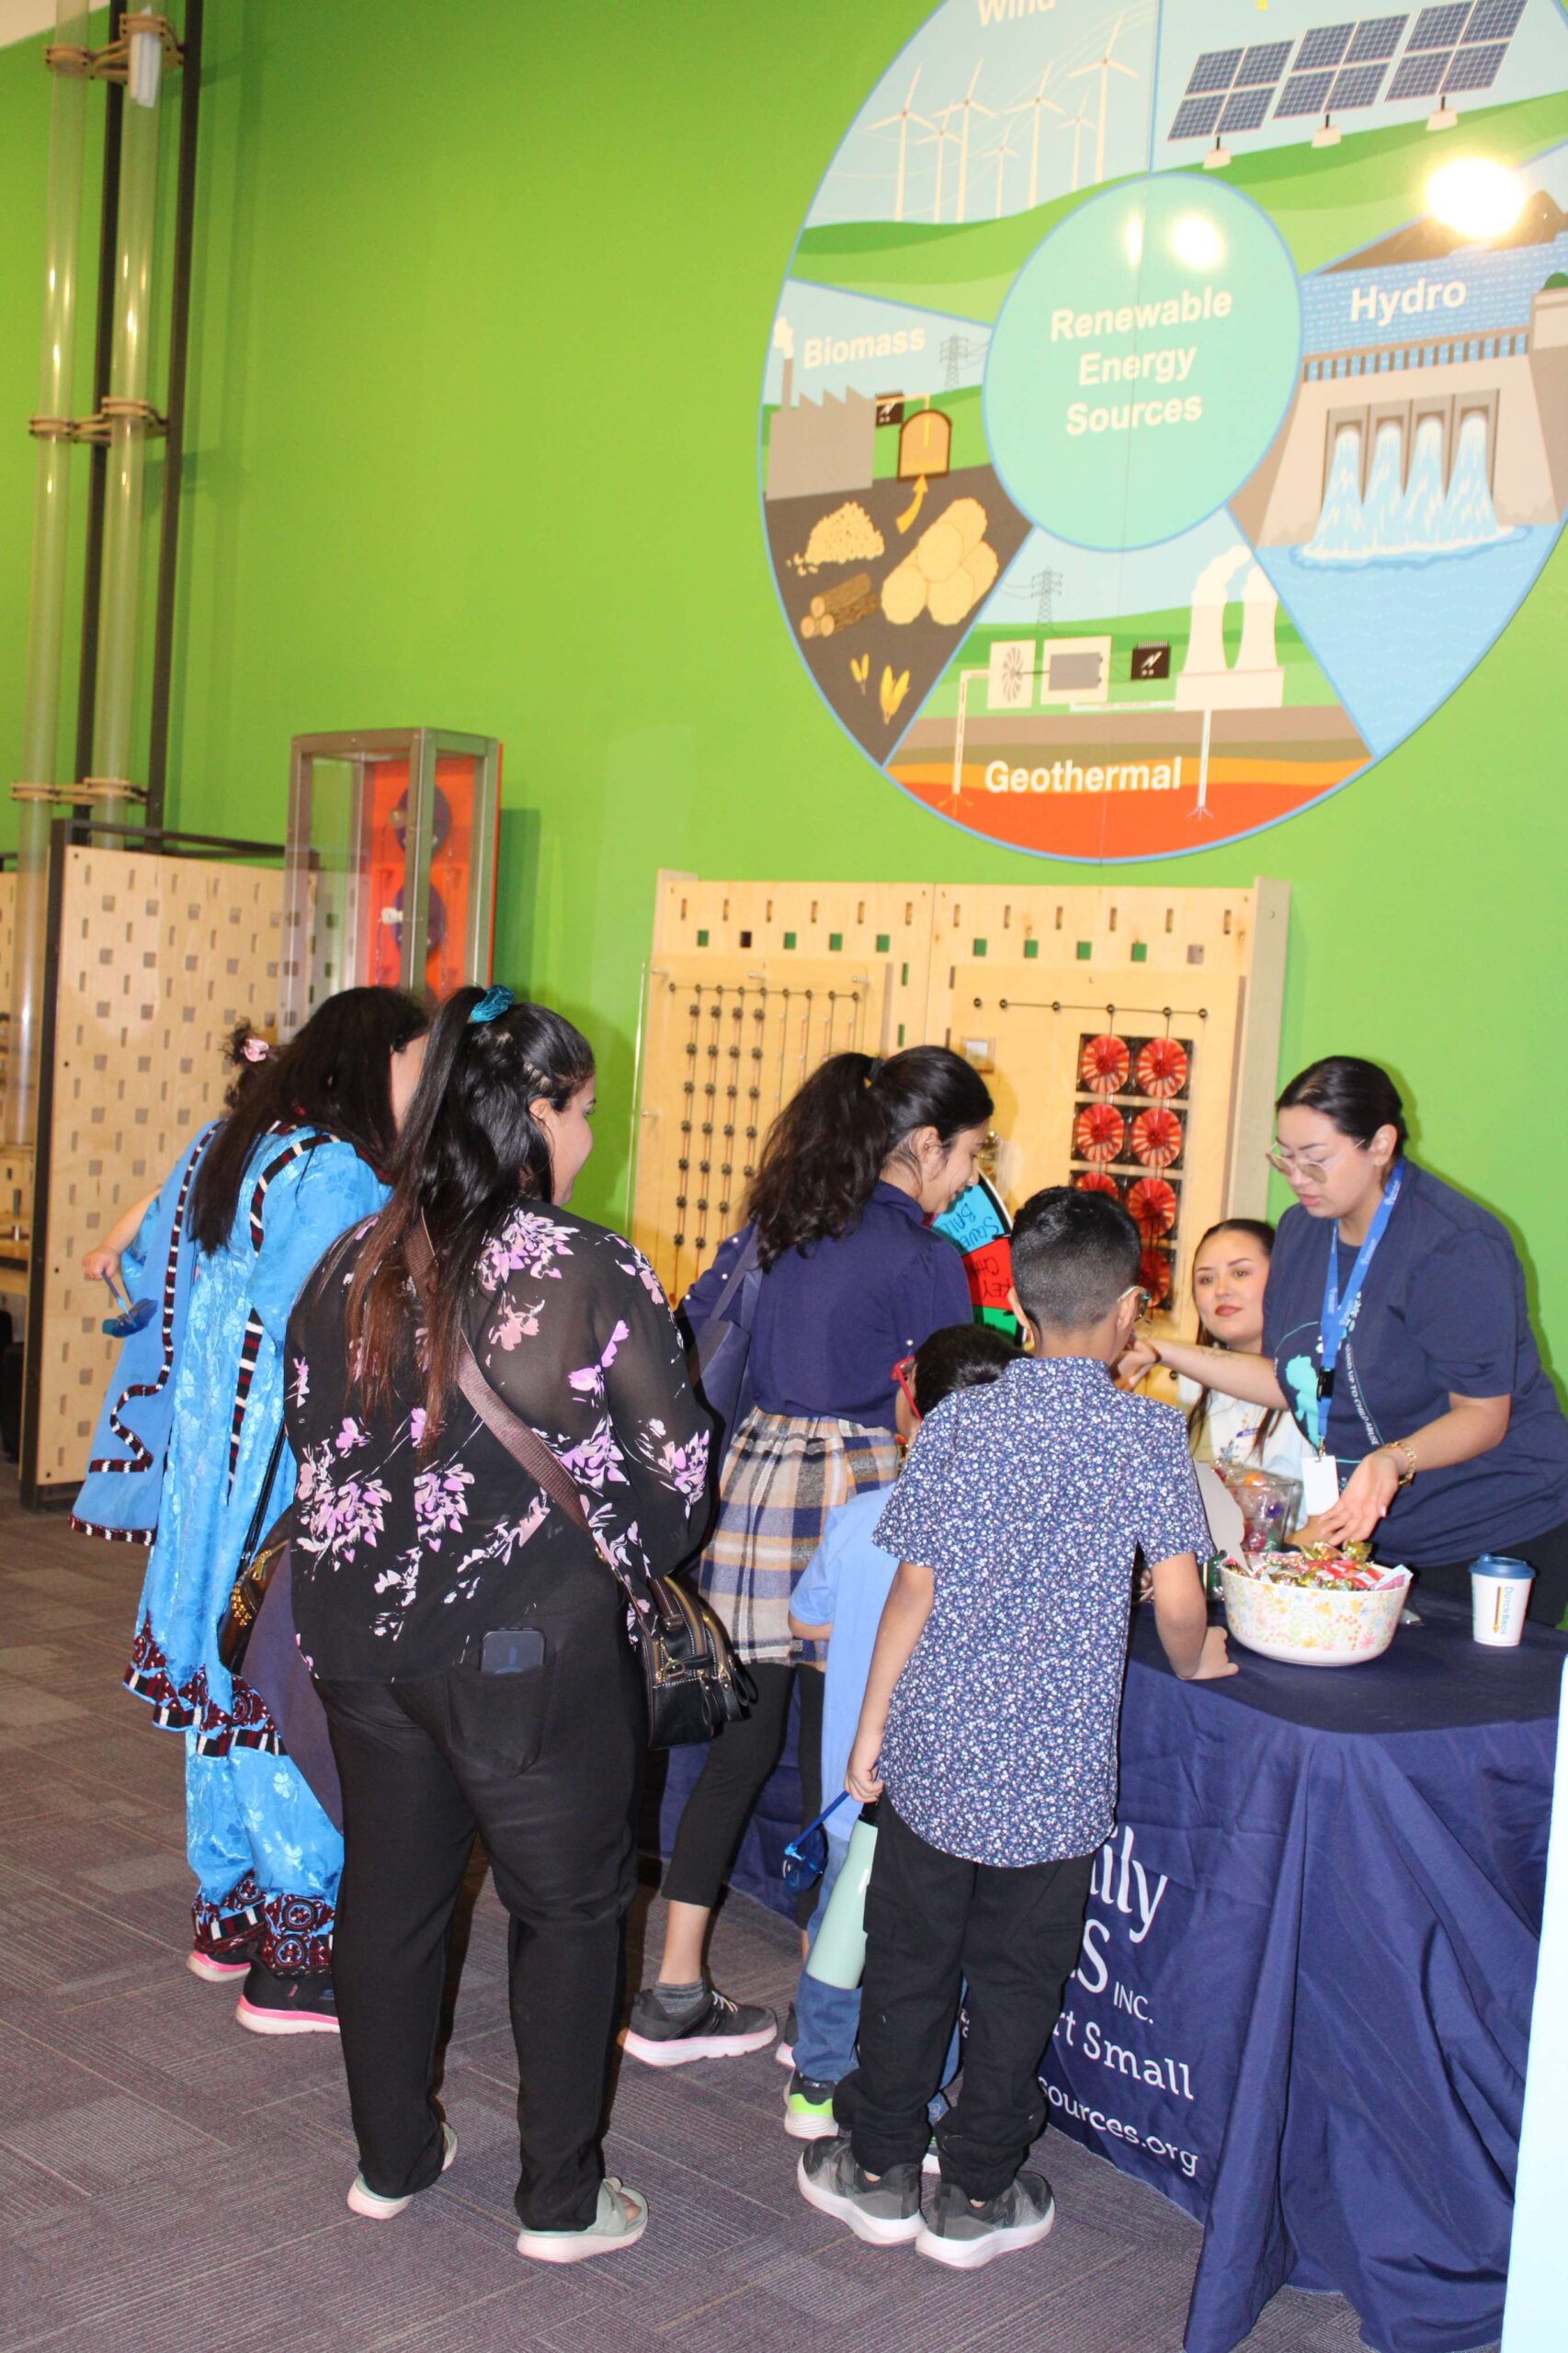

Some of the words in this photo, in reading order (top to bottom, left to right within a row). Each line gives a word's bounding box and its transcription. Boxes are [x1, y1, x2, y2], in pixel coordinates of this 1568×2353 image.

[1051, 286, 1233, 342] Renewable
[1350, 278, 1468, 327] Hydro
[803, 327, 926, 369] Biomass
[1079, 345, 1198, 386] Energy
[1066, 394, 1203, 436] Sources
[984, 756, 1183, 794] Geothermal
[962, 1216, 1000, 1249] SQUE
[1349, 1385, 1359, 1397] TO
[1113, 1981, 1154, 2025] INC.
[1084, 2021, 1194, 2100] Small
